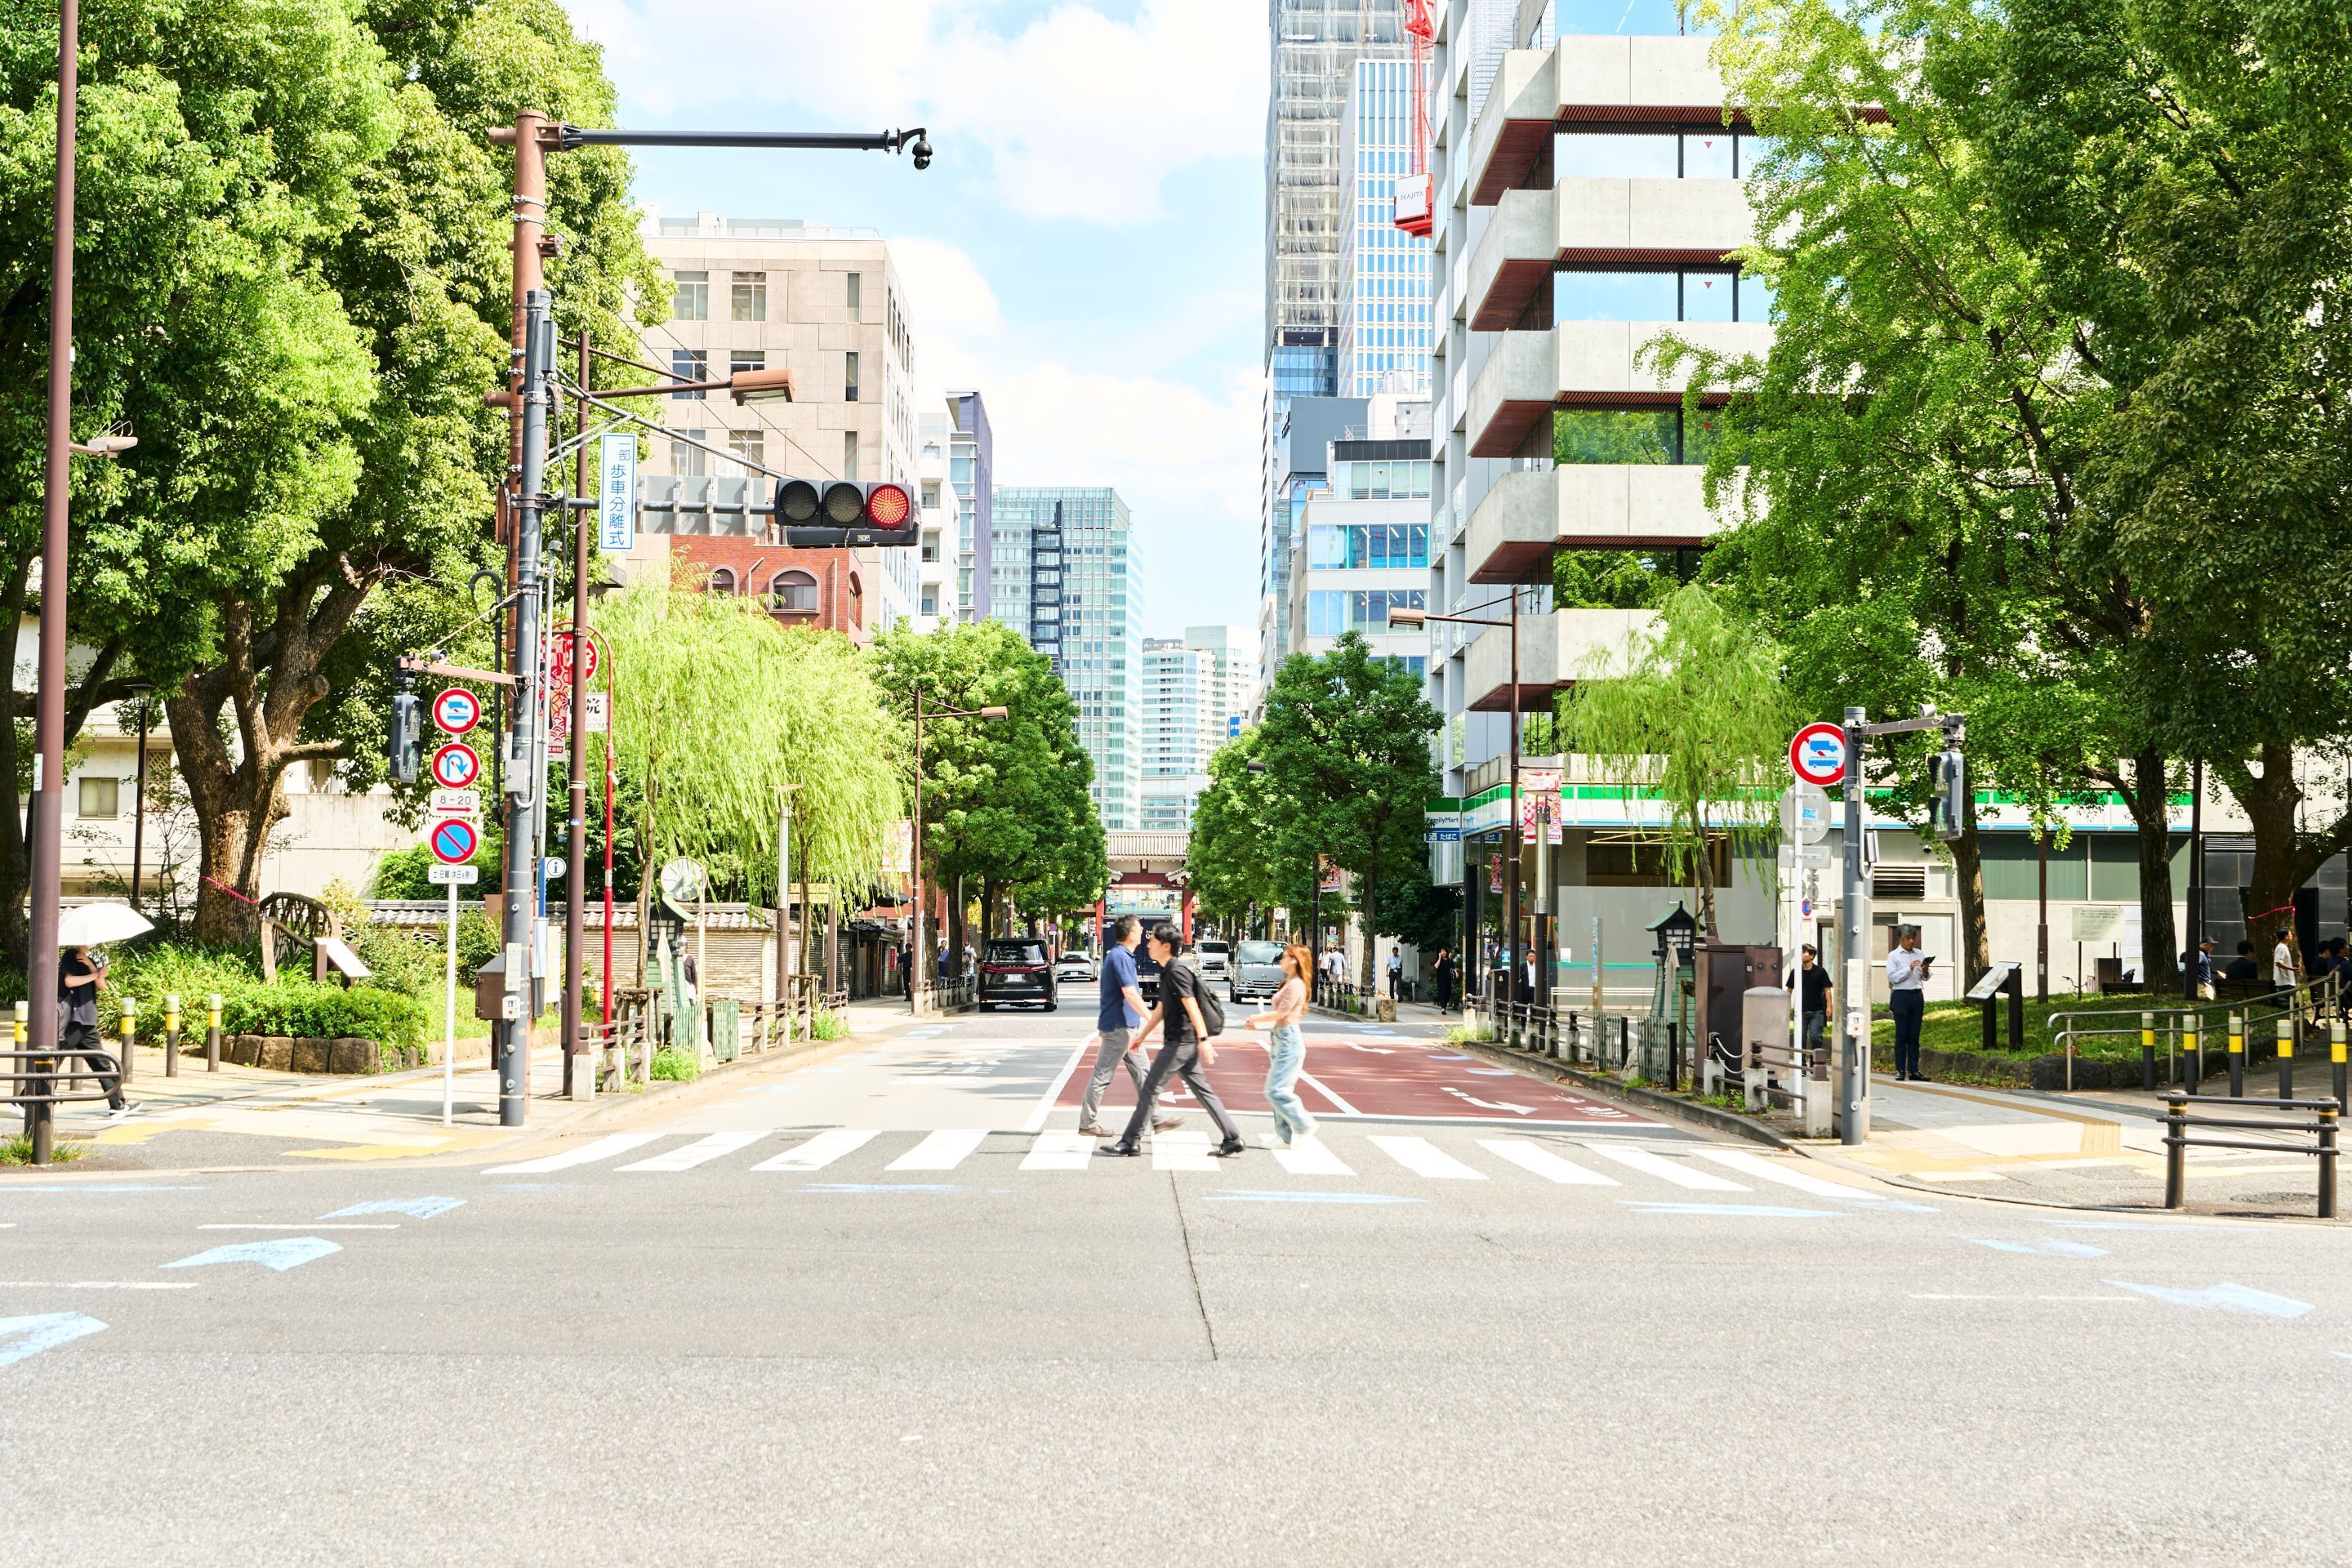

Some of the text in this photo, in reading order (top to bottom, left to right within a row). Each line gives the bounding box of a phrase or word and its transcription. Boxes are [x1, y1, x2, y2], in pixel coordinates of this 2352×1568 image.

[618, 443, 631, 461] 一部
[610, 464, 626, 546] 歩車分離式
[440, 795, 471, 804] 8-20
[1428, 832, 1437, 841] 酒
